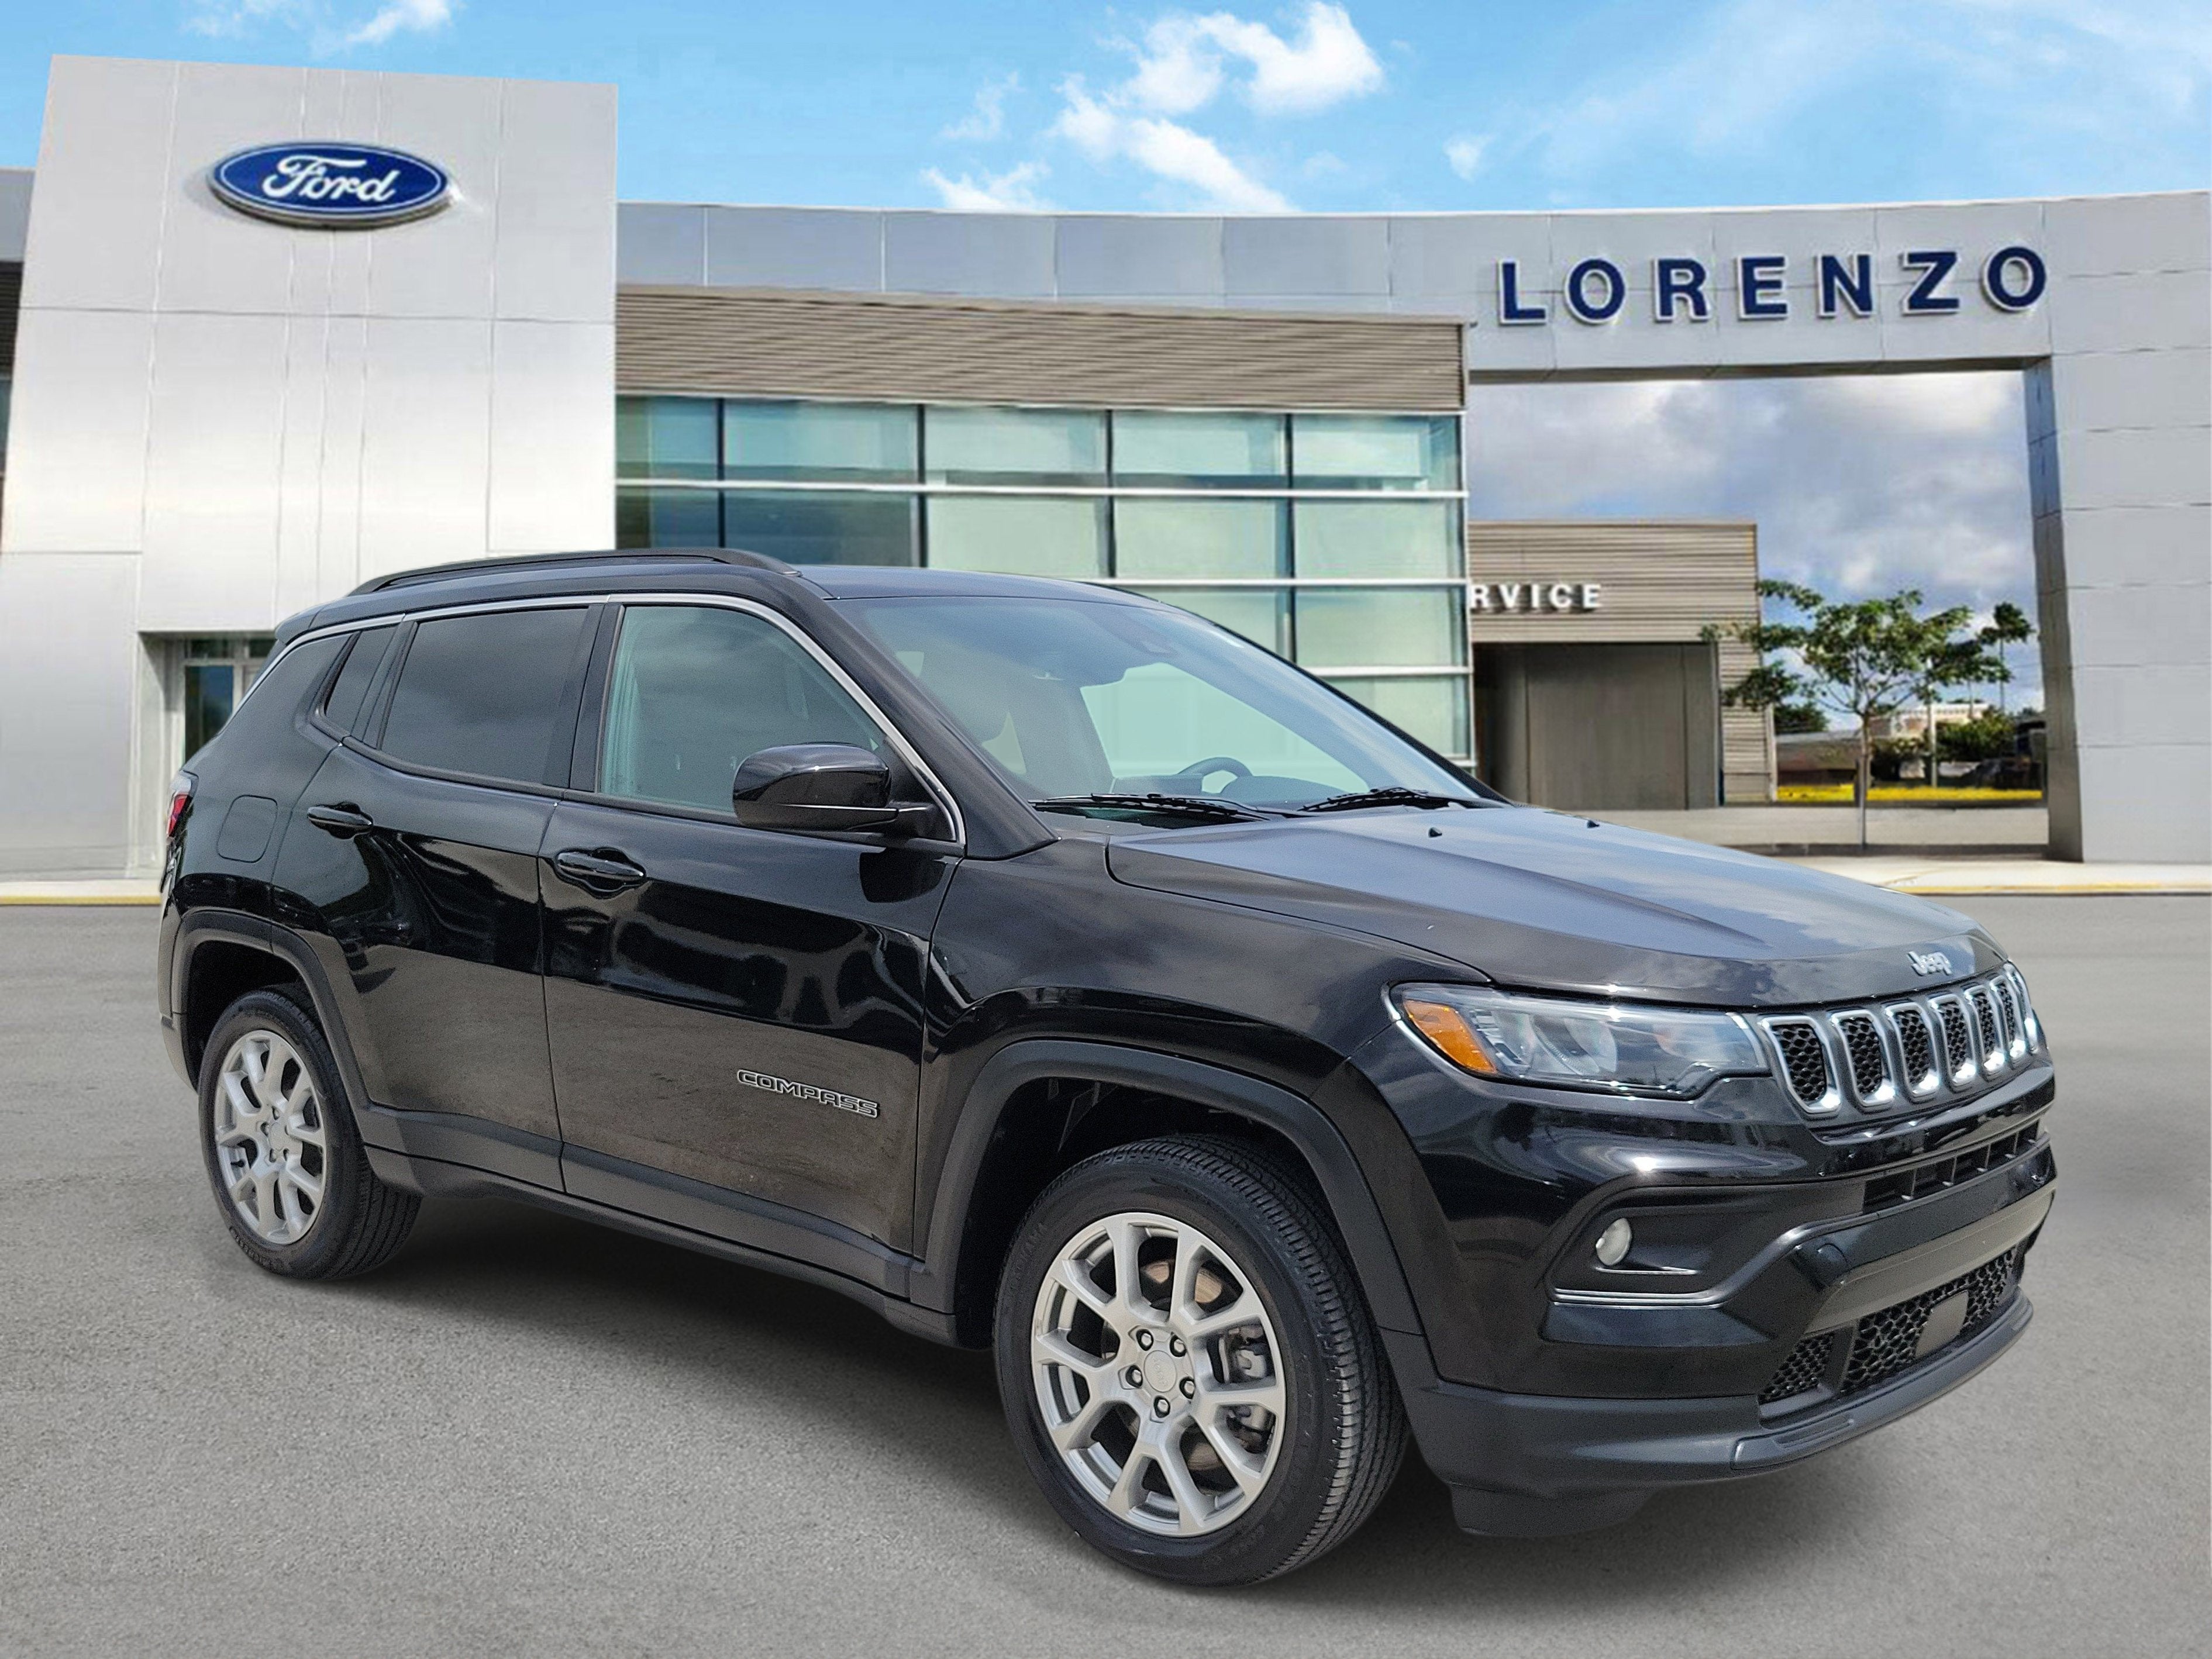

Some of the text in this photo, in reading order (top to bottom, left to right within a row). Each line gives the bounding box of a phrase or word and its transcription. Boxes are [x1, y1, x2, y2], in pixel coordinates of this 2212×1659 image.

[261, 154, 401, 202] Ford
[1497, 246, 2047, 325] LORENZO
[1469, 584, 1601, 608] RVICE
[1907, 950, 1952, 976] Jeep
[737, 1070, 878, 1118] COMPASS
